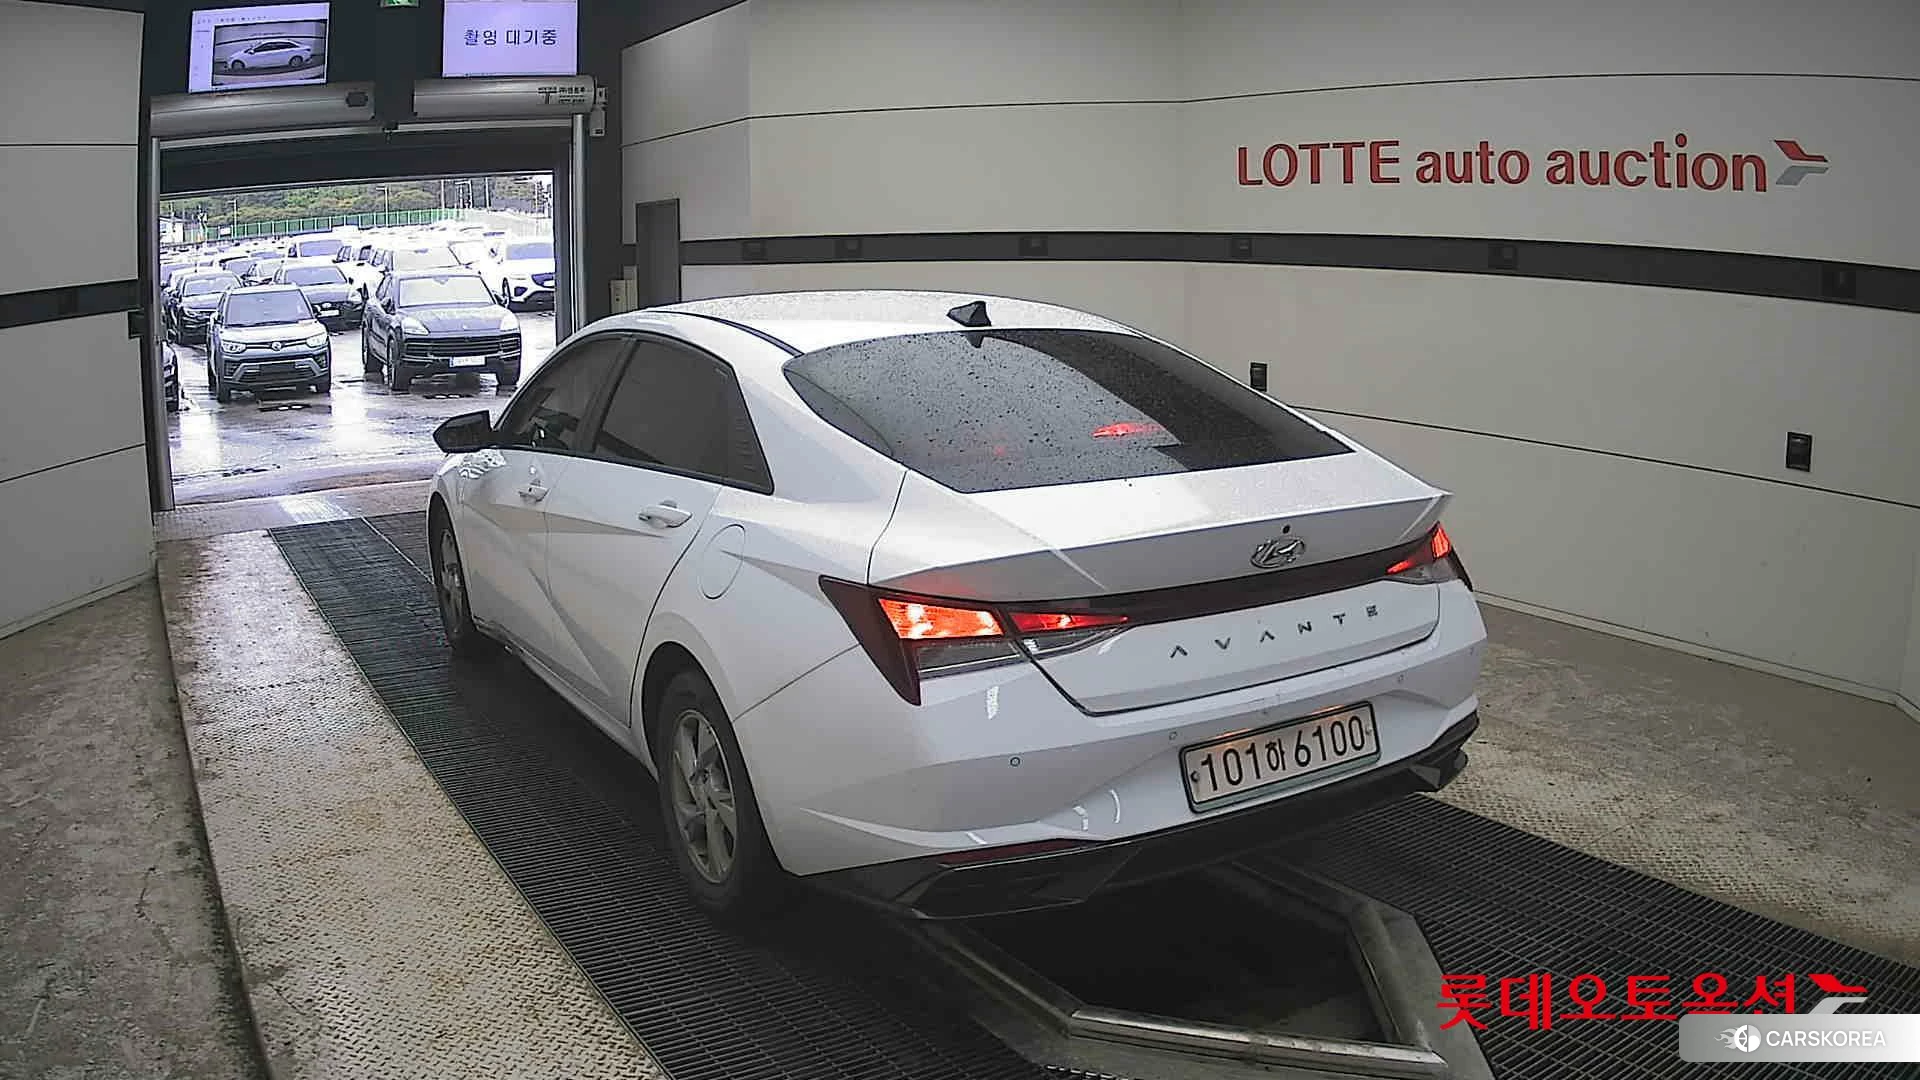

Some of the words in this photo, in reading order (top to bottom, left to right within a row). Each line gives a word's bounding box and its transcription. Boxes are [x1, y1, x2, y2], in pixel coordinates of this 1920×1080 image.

[505, 29, 558, 46] 대기중
[1236, 139, 1401, 187] LOTTE
[1415, 140, 1530, 185] auto
[1545, 133, 1768, 192] auction
[1169, 604, 1378, 659] AVANTE
